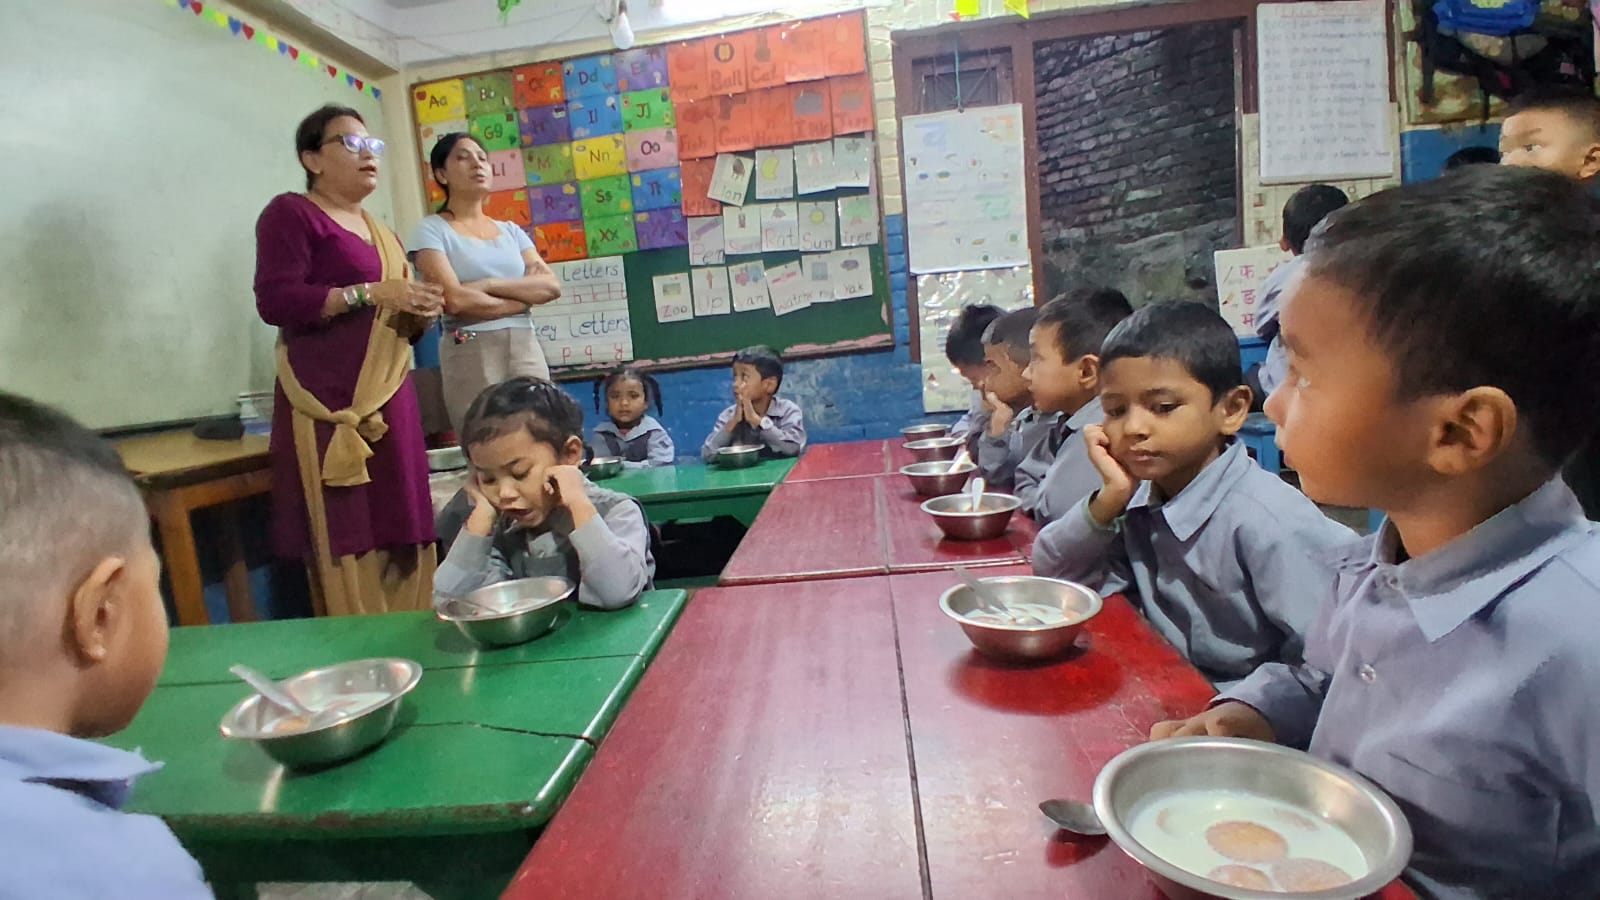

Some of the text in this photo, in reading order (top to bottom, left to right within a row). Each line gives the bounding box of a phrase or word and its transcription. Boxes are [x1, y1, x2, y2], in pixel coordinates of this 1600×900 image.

[578, 67, 598, 86] Dd
[711, 69, 743, 91] Ball
[429, 95, 448, 110] Aa
[484, 123, 503, 140] Gg
[589, 149, 610, 163] Nn
[640, 140, 661, 155] Oo
[594, 188, 613, 204] Ss
[802, 231, 833, 250] Sun
[562, 263, 619, 282] Letters
[662, 304, 688, 318] Zoo
[569, 311, 629, 338] Letters
